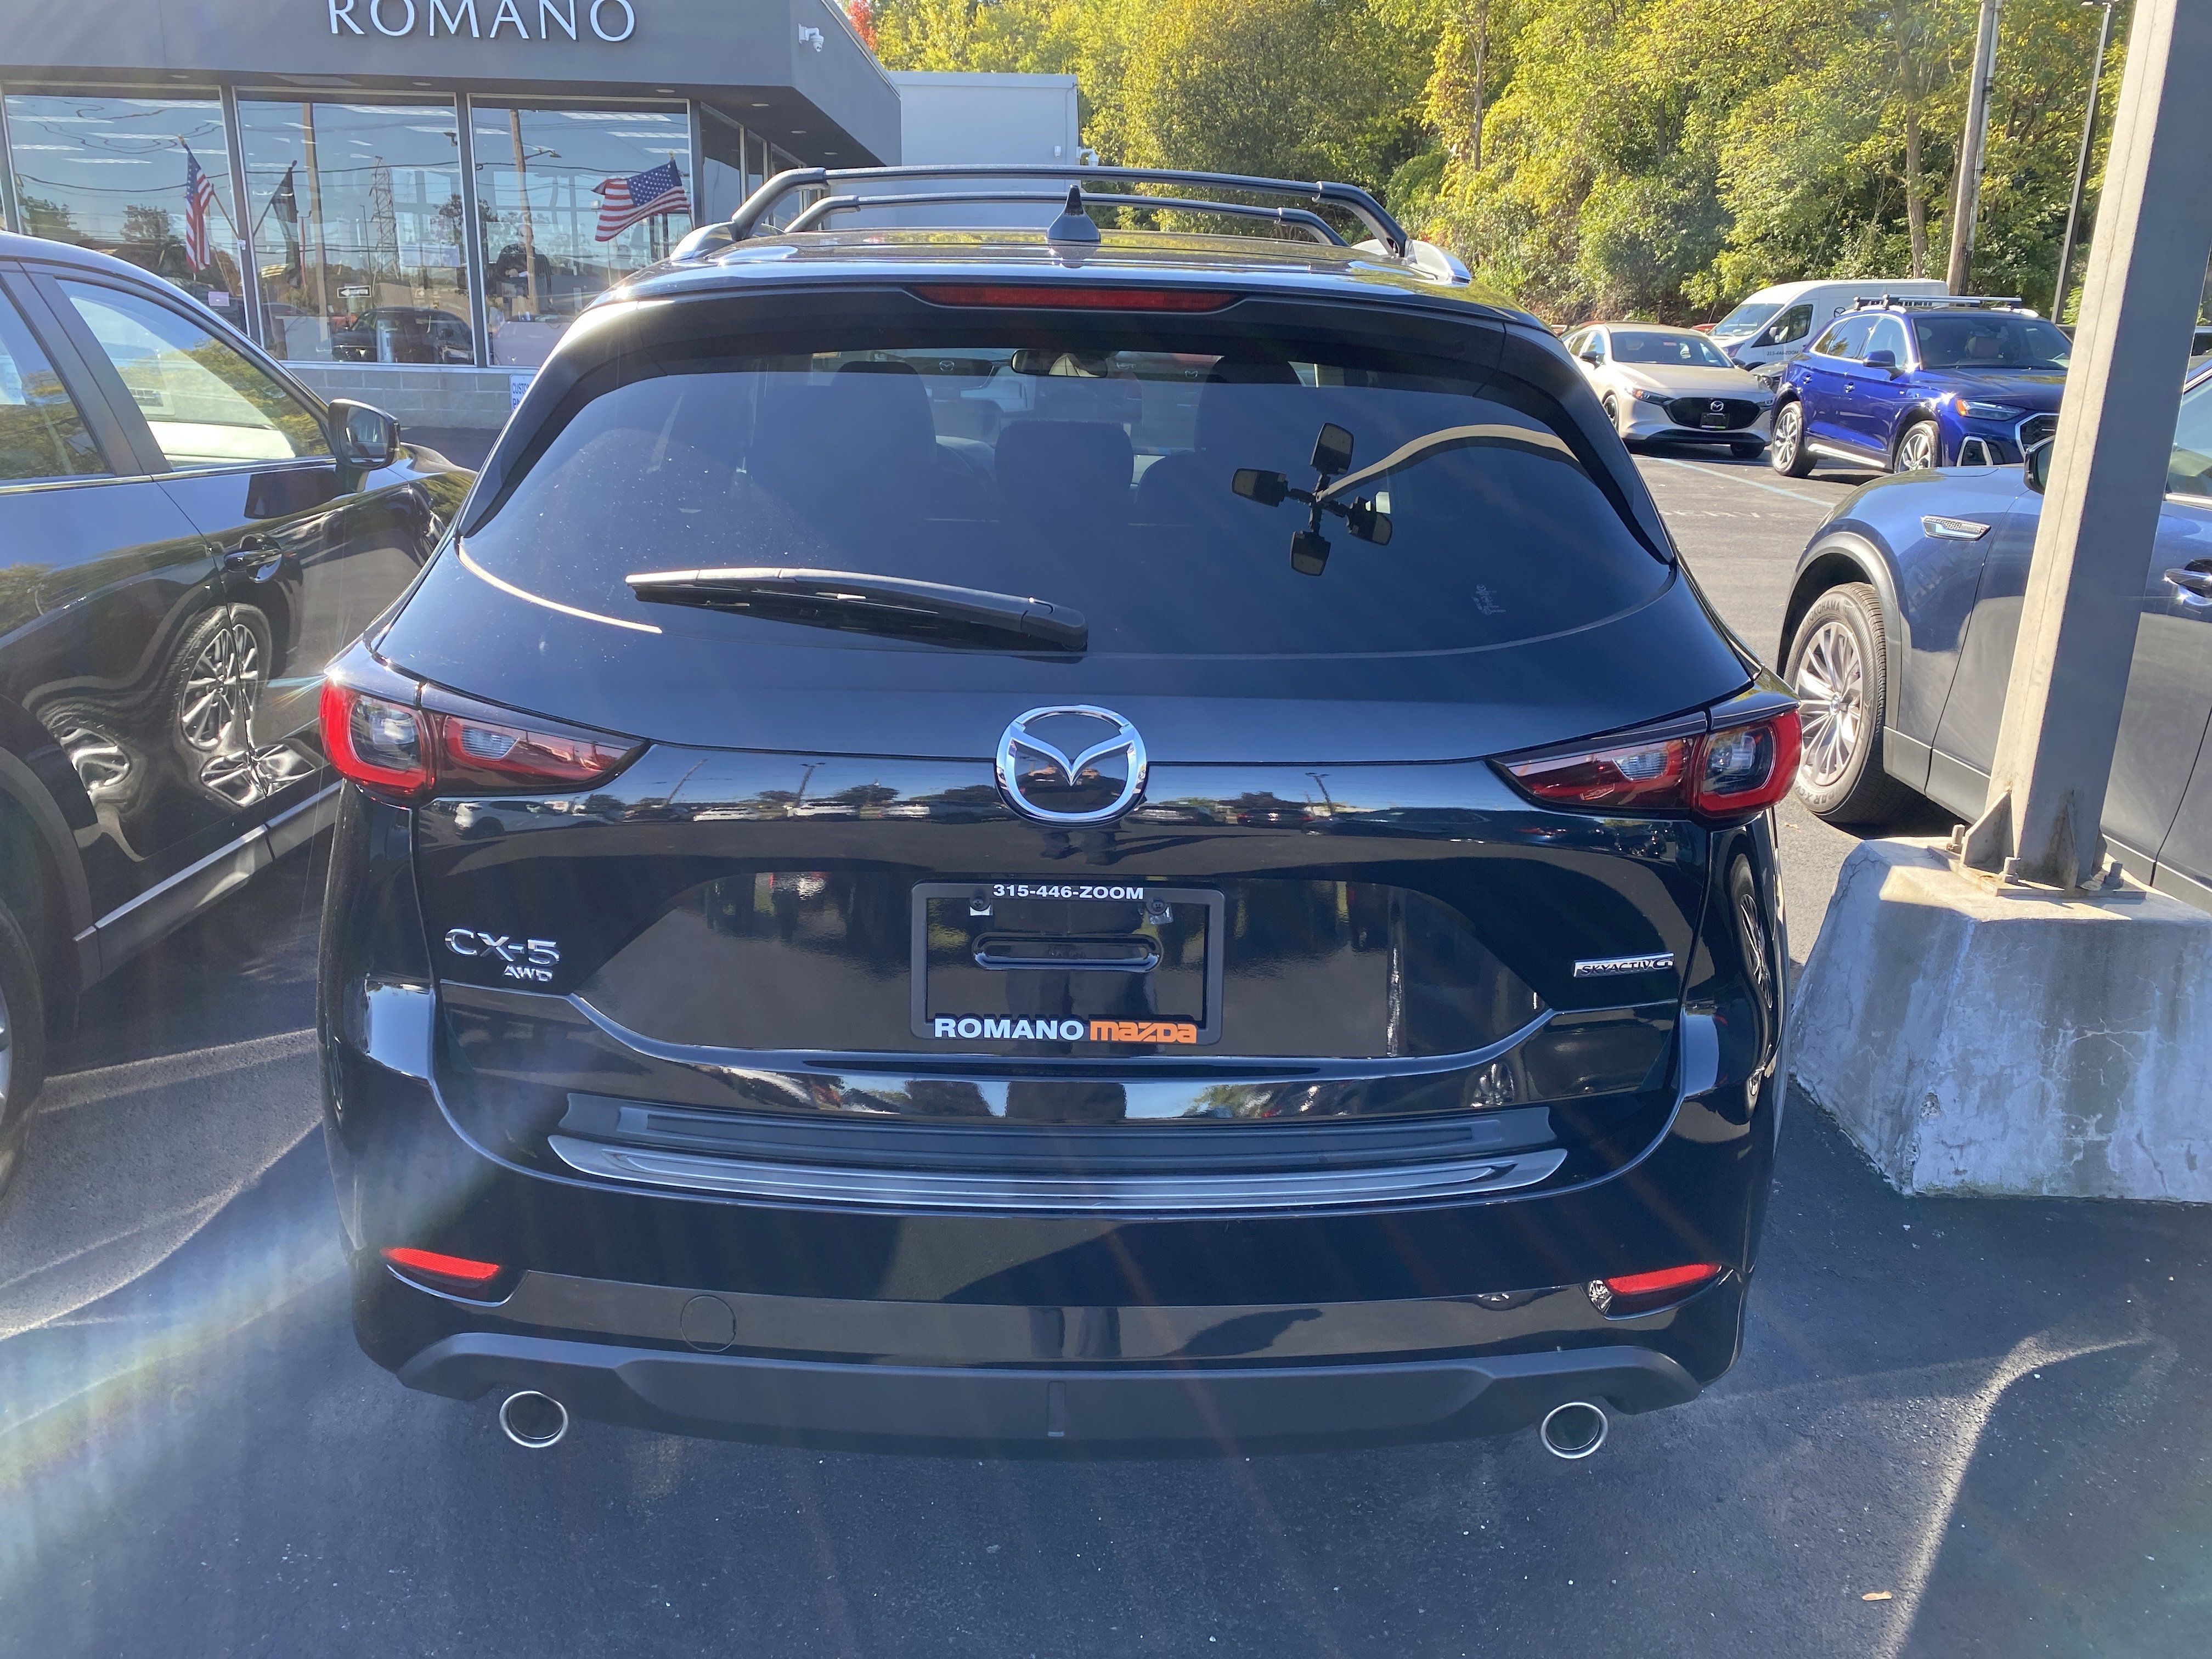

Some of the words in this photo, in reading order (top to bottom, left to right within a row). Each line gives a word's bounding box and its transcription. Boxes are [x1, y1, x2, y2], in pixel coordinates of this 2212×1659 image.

[329, 0, 635, 42] ROMANO
[511, 382, 529, 394] CUSTO
[993, 884, 1144, 900] 315-446-ZOOM
[445, 927, 561, 967] CX-5
[503, 964, 554, 983] AWD
[934, 1017, 1085, 1041] ROMANO
[1089, 1019, 1197, 1043] mazda
